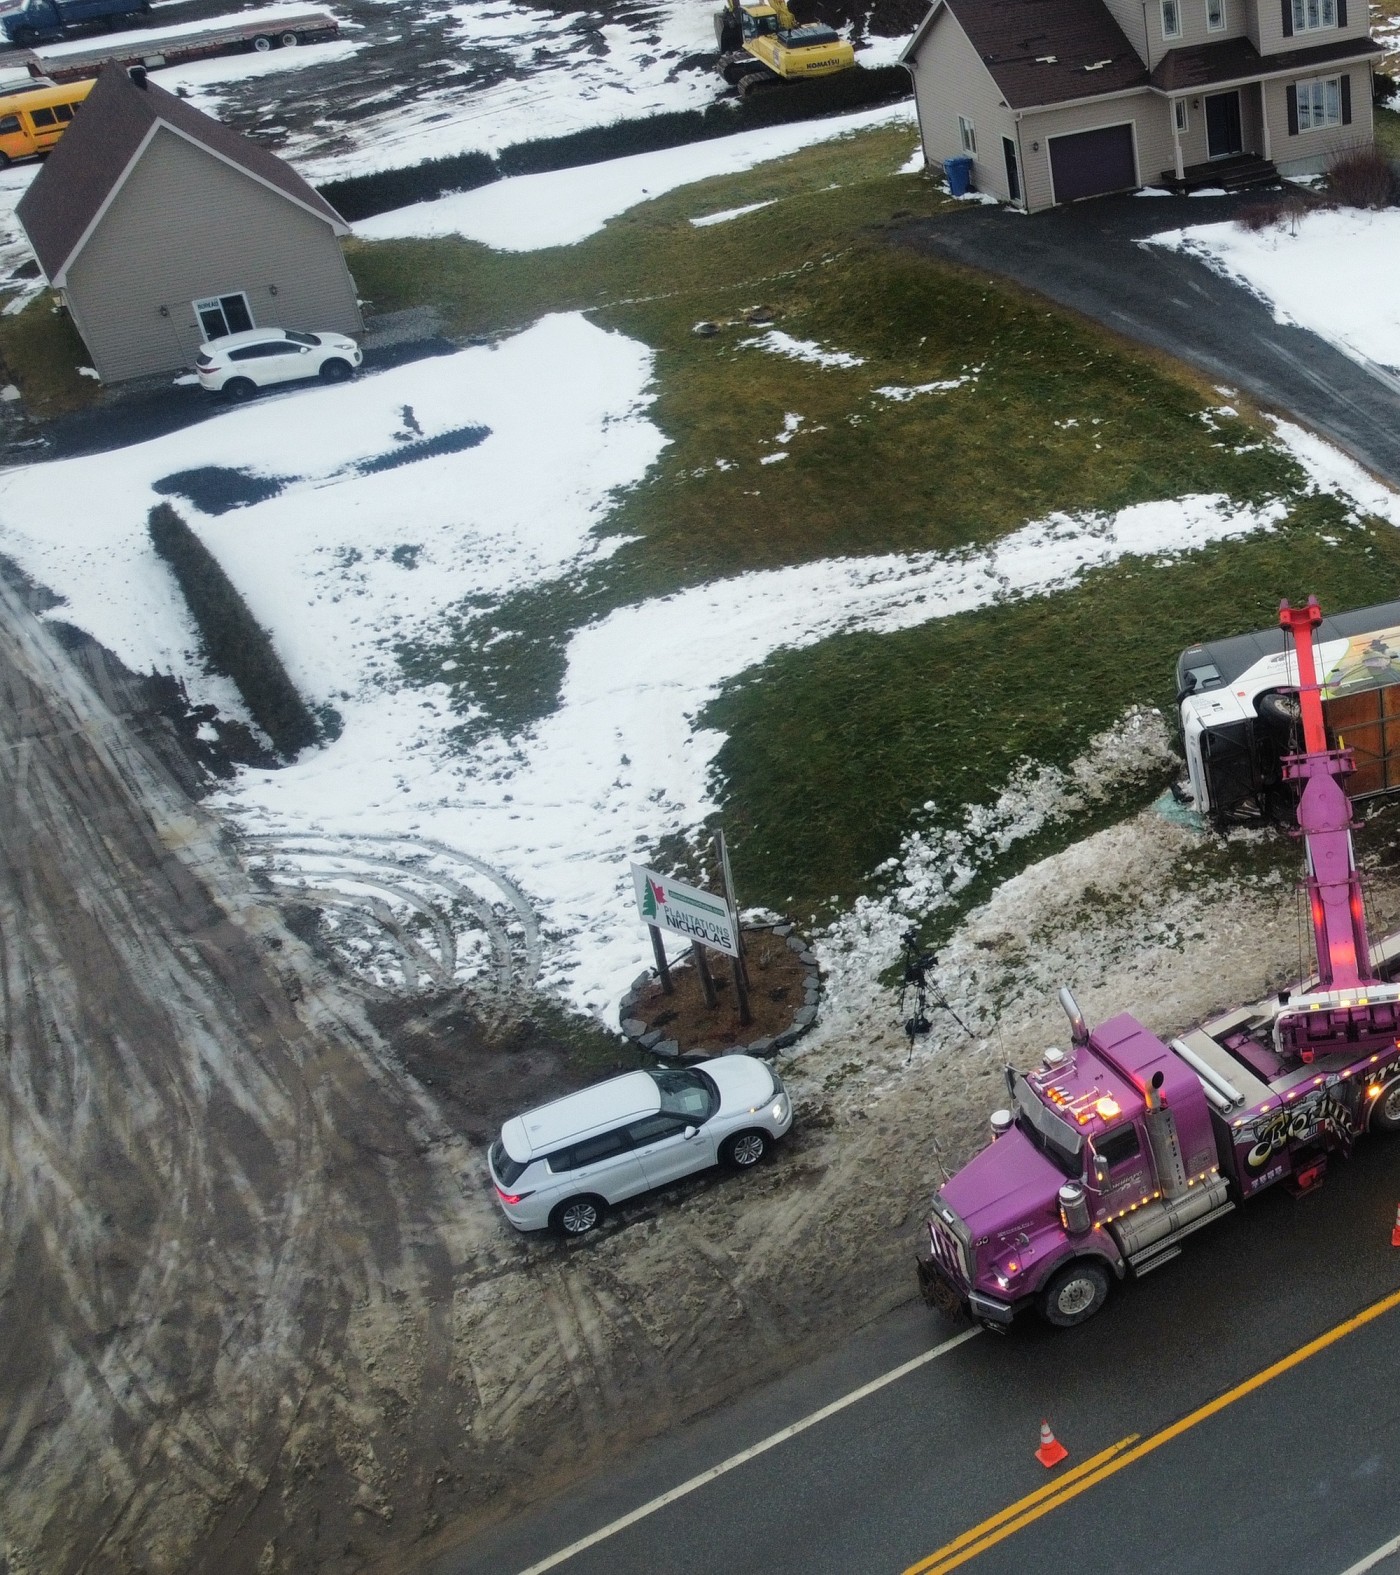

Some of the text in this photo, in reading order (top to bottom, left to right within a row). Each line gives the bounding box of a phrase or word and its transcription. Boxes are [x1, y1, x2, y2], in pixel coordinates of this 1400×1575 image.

[806, 58, 840, 70] KOMATSU
[664, 905, 730, 938] PLANTATIONS
[666, 916, 732, 949] NICHOLAS
